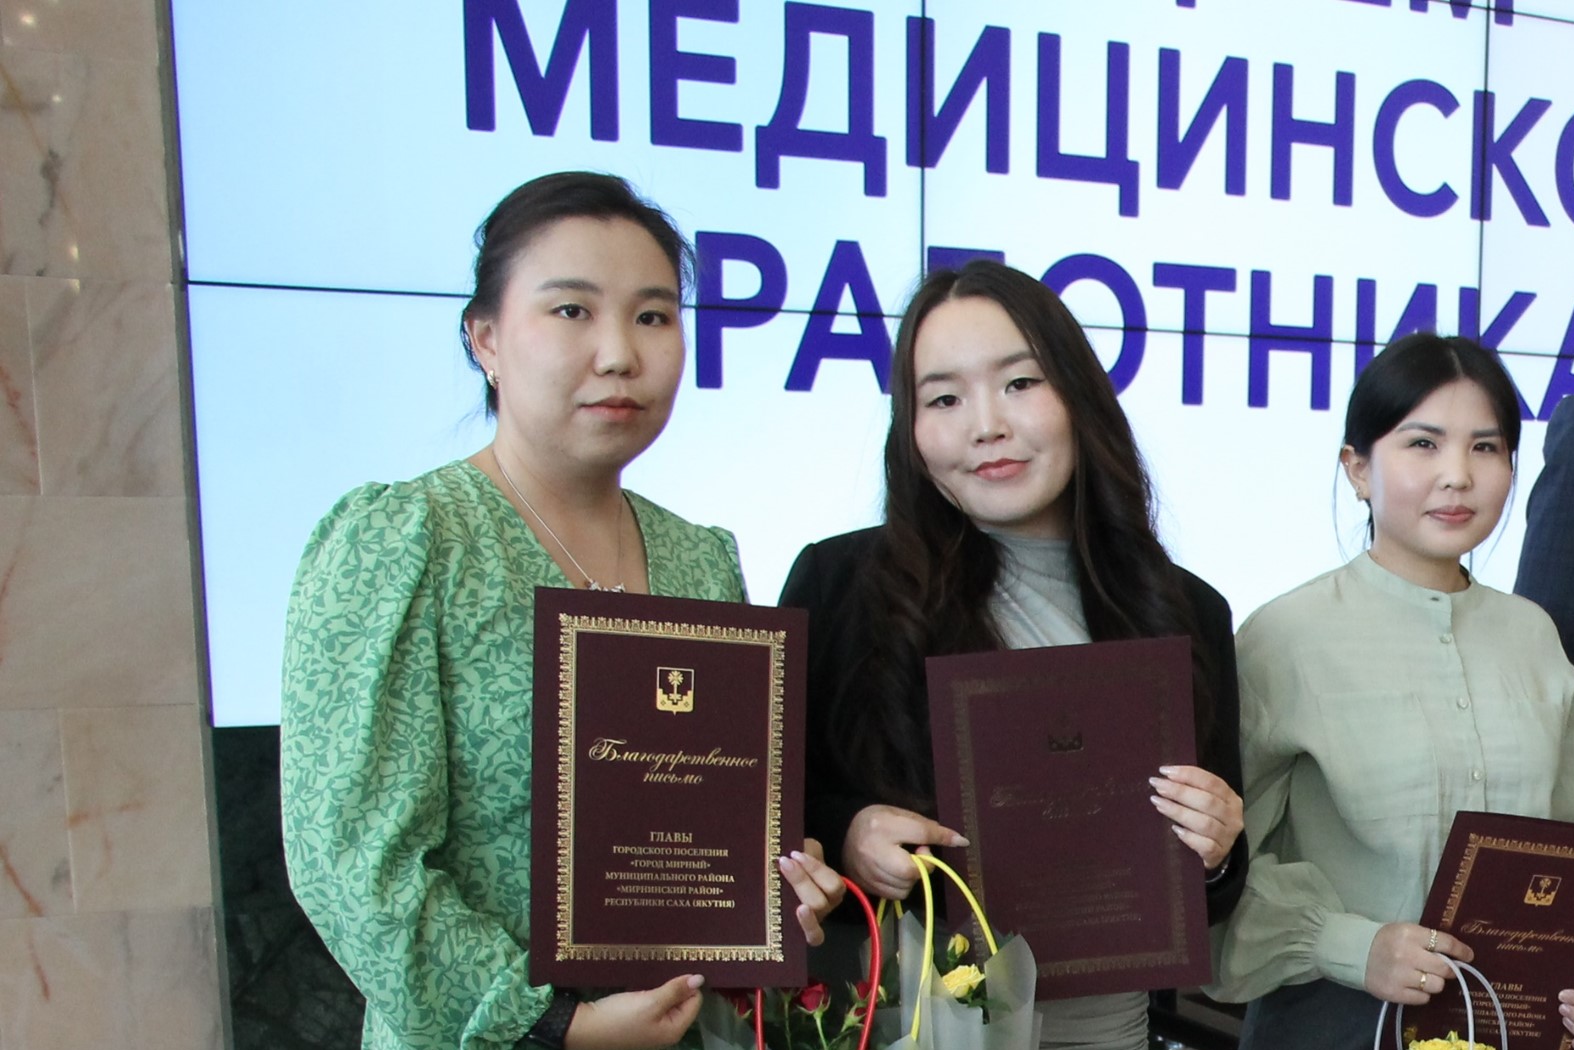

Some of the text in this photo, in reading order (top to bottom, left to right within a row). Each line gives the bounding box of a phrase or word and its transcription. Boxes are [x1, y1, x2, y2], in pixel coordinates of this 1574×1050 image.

[588, 737, 758, 772] Благодарственное
[643, 772, 704, 785] письмо
[650, 831, 693, 843] ГЛАВЫ
[612, 845, 729, 857] ГОРОДСКОГО ПОСЕЛЕНИЯ
[605, 872, 735, 883] МУНИЦИПАЛЬНОГО РАЙОНА
[604, 898, 736, 909] РЕСПУБЛИКИ САХА (ЯКУТИЯ)
[1490, 982, 1523, 992] ГЛАВЫ
